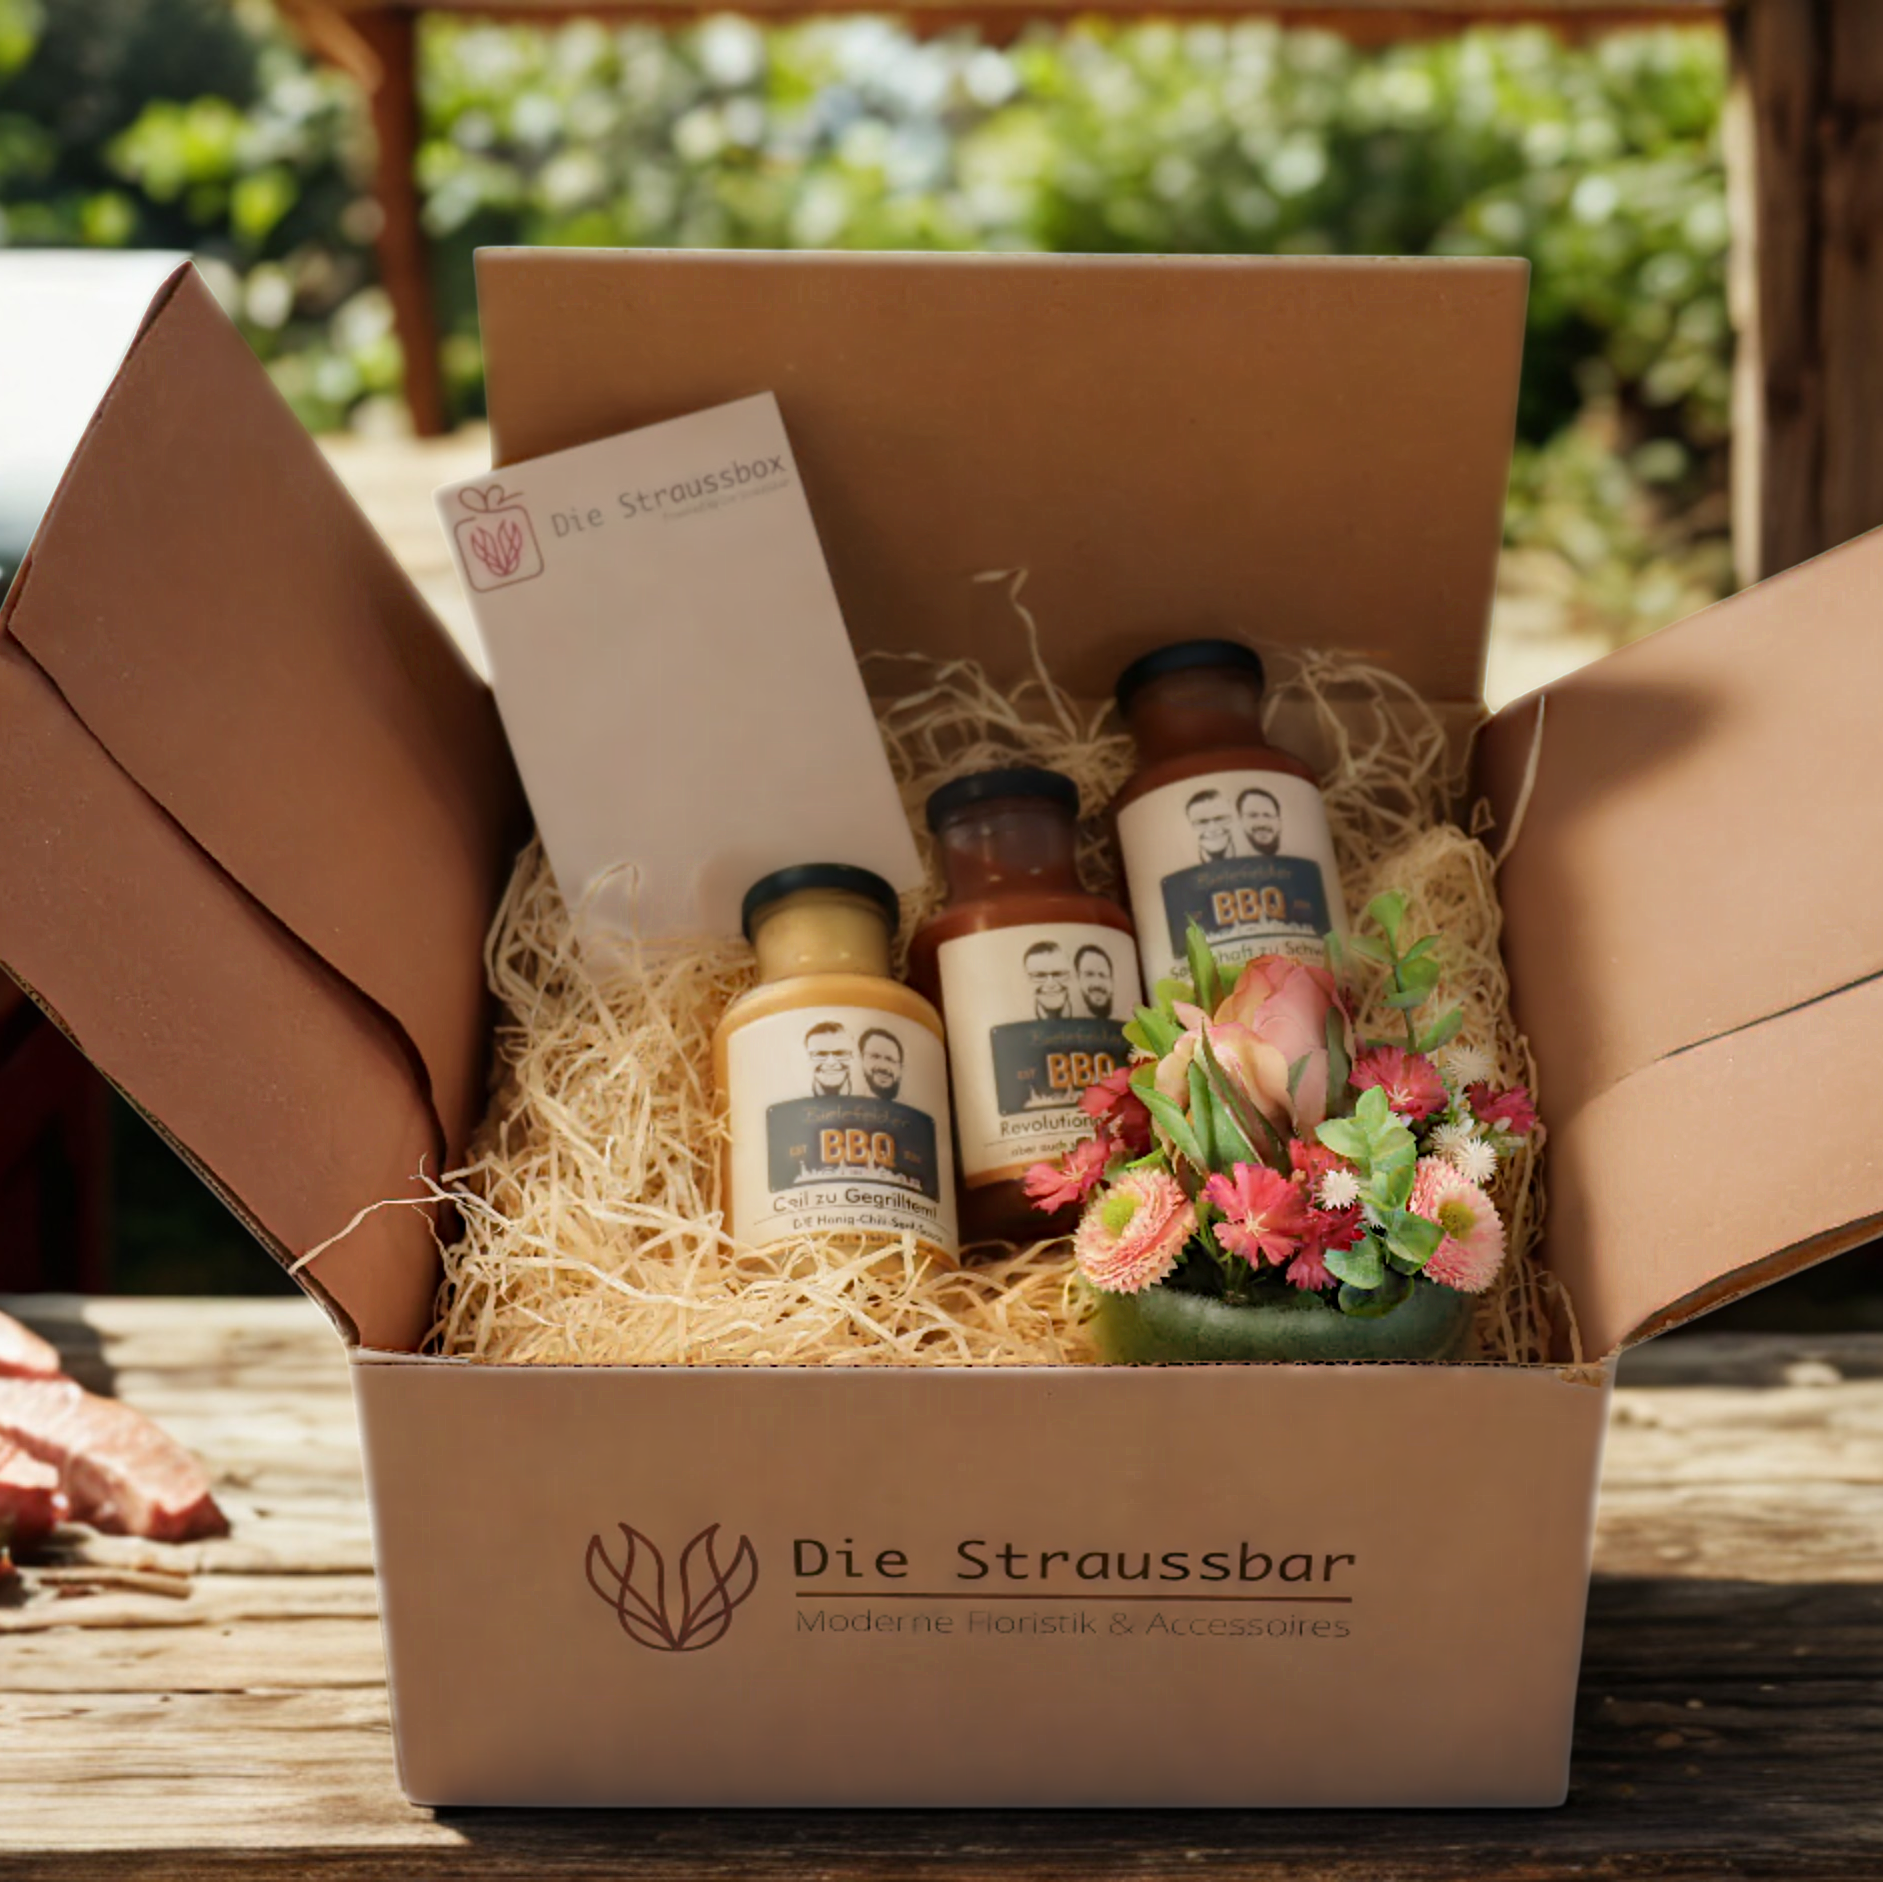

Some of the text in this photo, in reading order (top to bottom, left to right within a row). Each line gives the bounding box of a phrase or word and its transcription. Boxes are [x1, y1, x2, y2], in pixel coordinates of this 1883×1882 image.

[551, 507, 605, 539] Die
[619, 455, 786, 519] Straussbox
[1211, 886, 1287, 926] BBQ
[819, 1128, 897, 1169] BBQ
[815, 1192, 837, 1205] zu
[793, 1537, 1356, 1582] Die Straussbar
[796, 1608, 1351, 1638] Moderne Floristik & Accessoires
